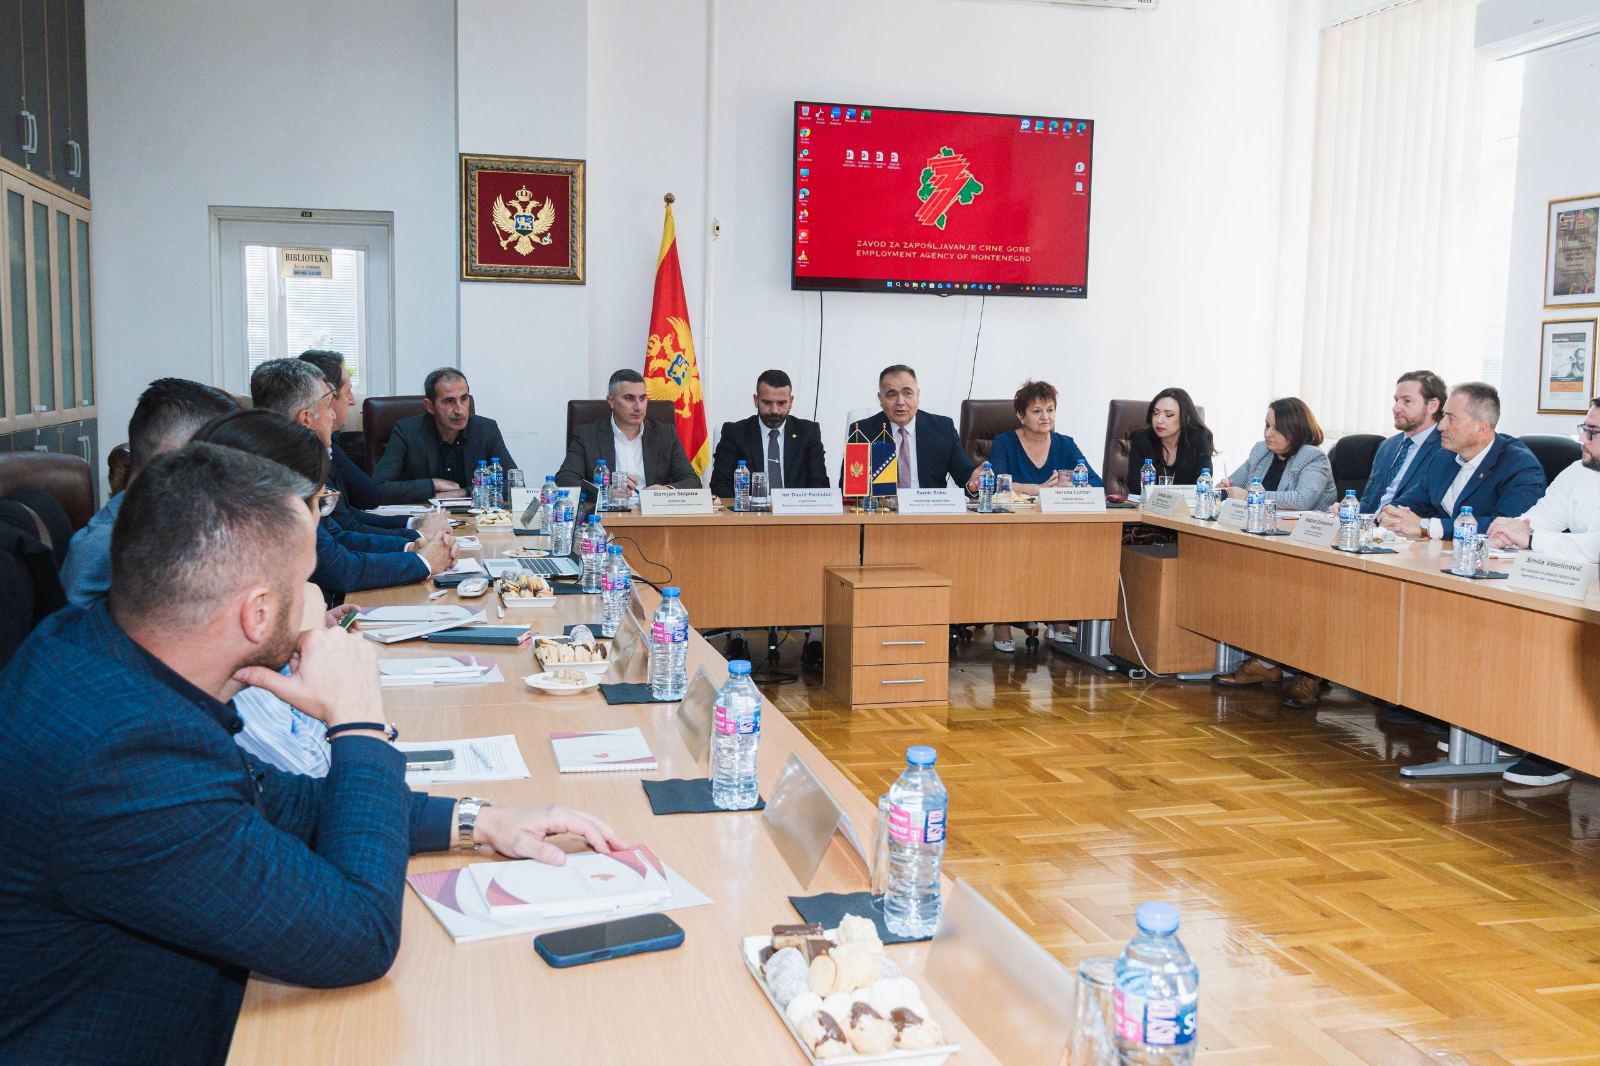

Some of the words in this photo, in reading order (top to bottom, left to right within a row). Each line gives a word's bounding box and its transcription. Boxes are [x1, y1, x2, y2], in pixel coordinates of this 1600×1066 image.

[856, 240, 887, 248] ZAVOD
[1006, 246, 1031, 254] GORE
[285, 253, 328, 263] BIBLIOTEKA
[856, 249, 917, 258] EMPLOYMENT
[920, 252, 955, 260] AGENCY
[971, 254, 1032, 263] MONTENEGRO
